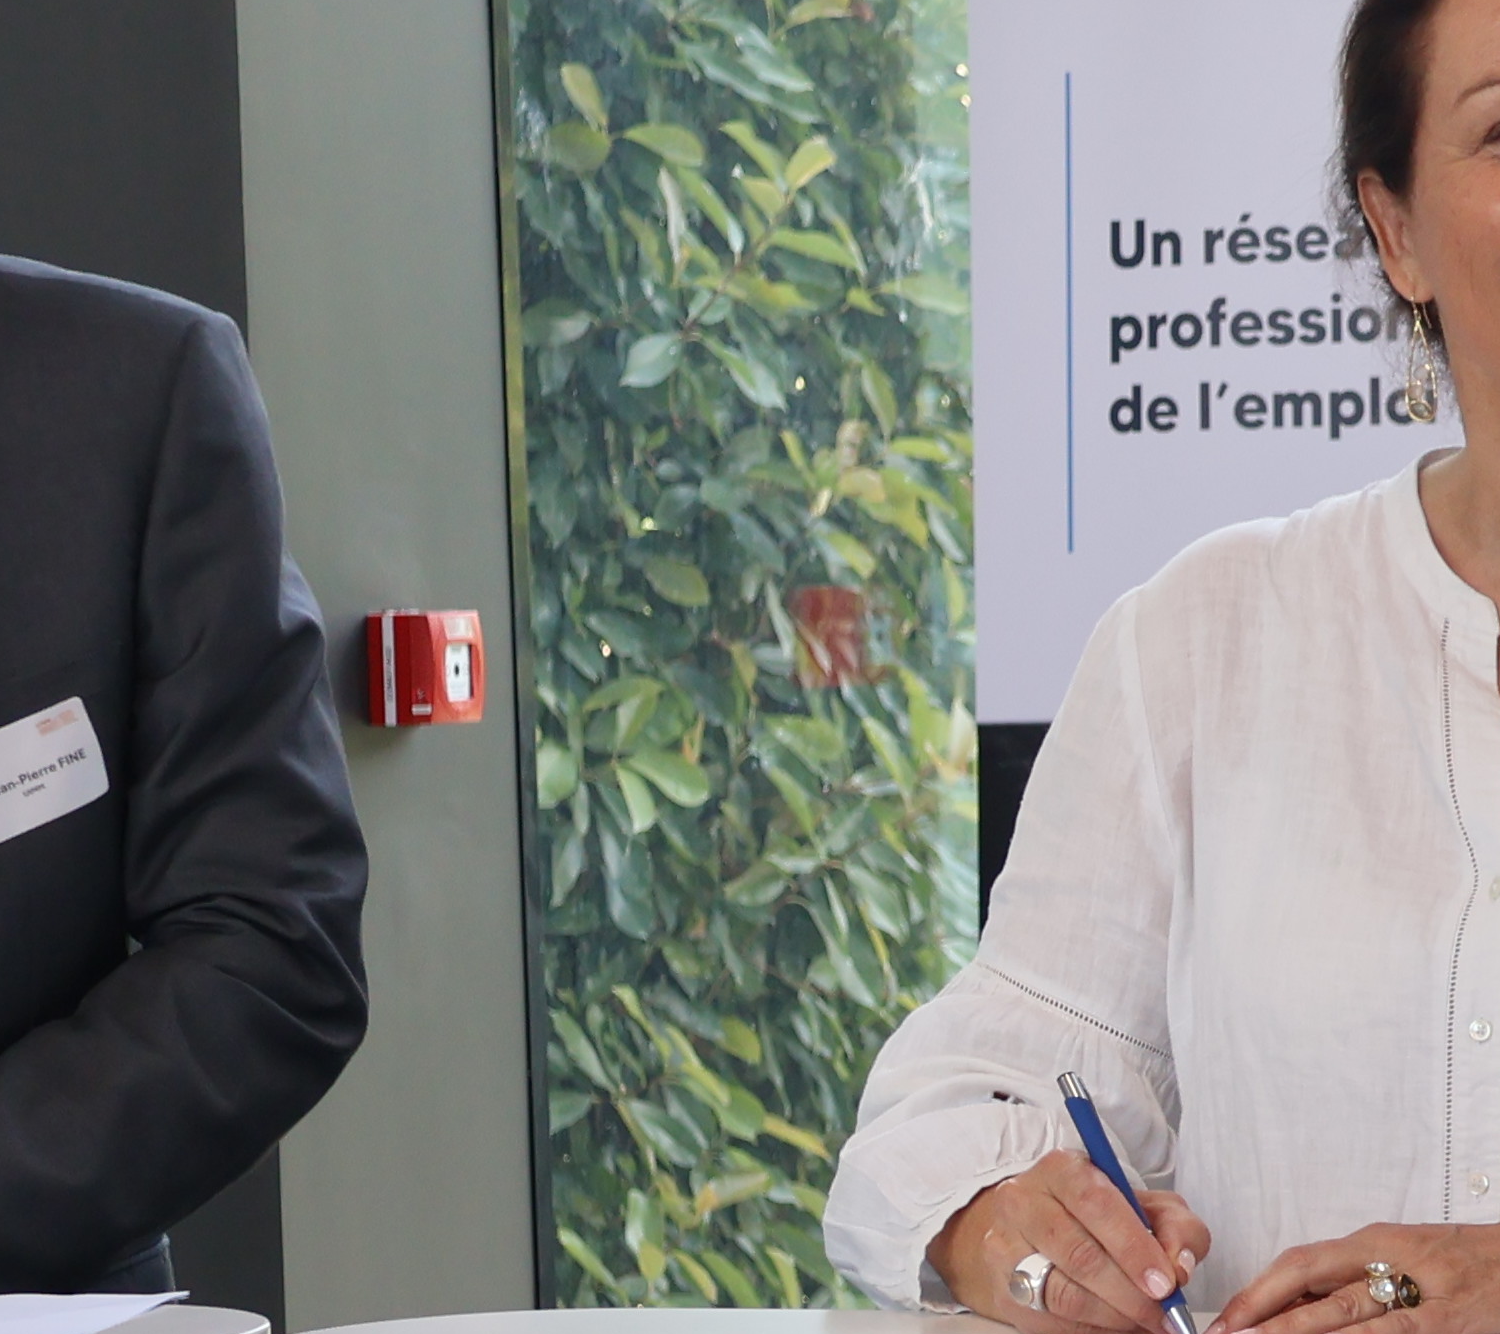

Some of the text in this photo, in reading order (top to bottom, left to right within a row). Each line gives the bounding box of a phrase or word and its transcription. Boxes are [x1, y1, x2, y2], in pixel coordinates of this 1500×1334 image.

[1108, 213, 1366, 268] Un résea
[1108, 384, 1180, 435] de
[57, 747, 87, 768] FINE
